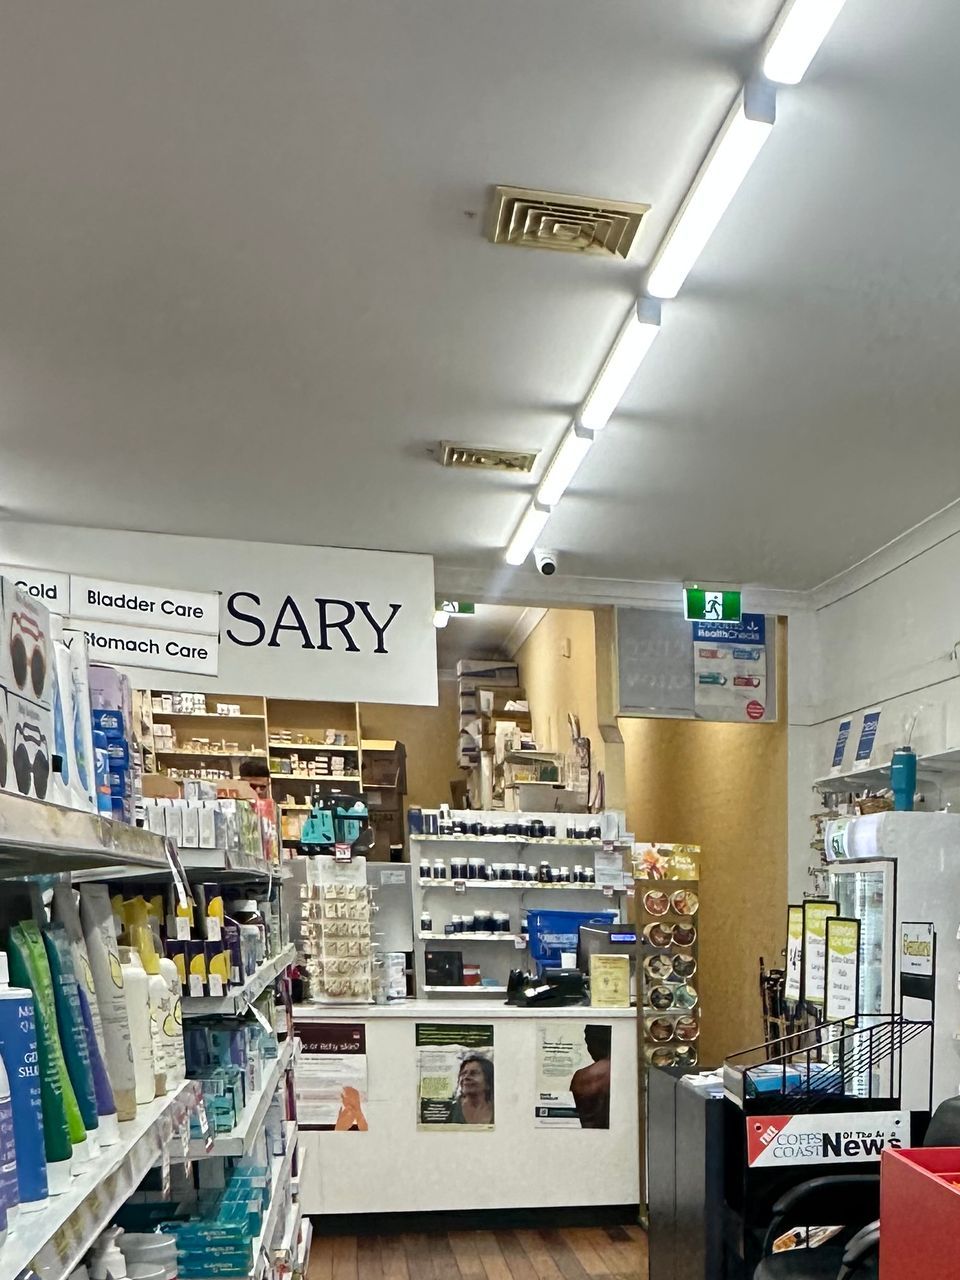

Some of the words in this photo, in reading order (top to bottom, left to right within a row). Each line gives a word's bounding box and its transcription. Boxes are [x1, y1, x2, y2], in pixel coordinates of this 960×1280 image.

[87, 590, 156, 612] Bladder
[161, 600, 204, 619] Care
[84, 631, 159, 654] Stomach
[166, 642, 208, 660] Care
[773, 1145, 822, 1158] COAST
[777, 1132, 822, 1146] COFFS
[822, 1132, 901, 1158] News
